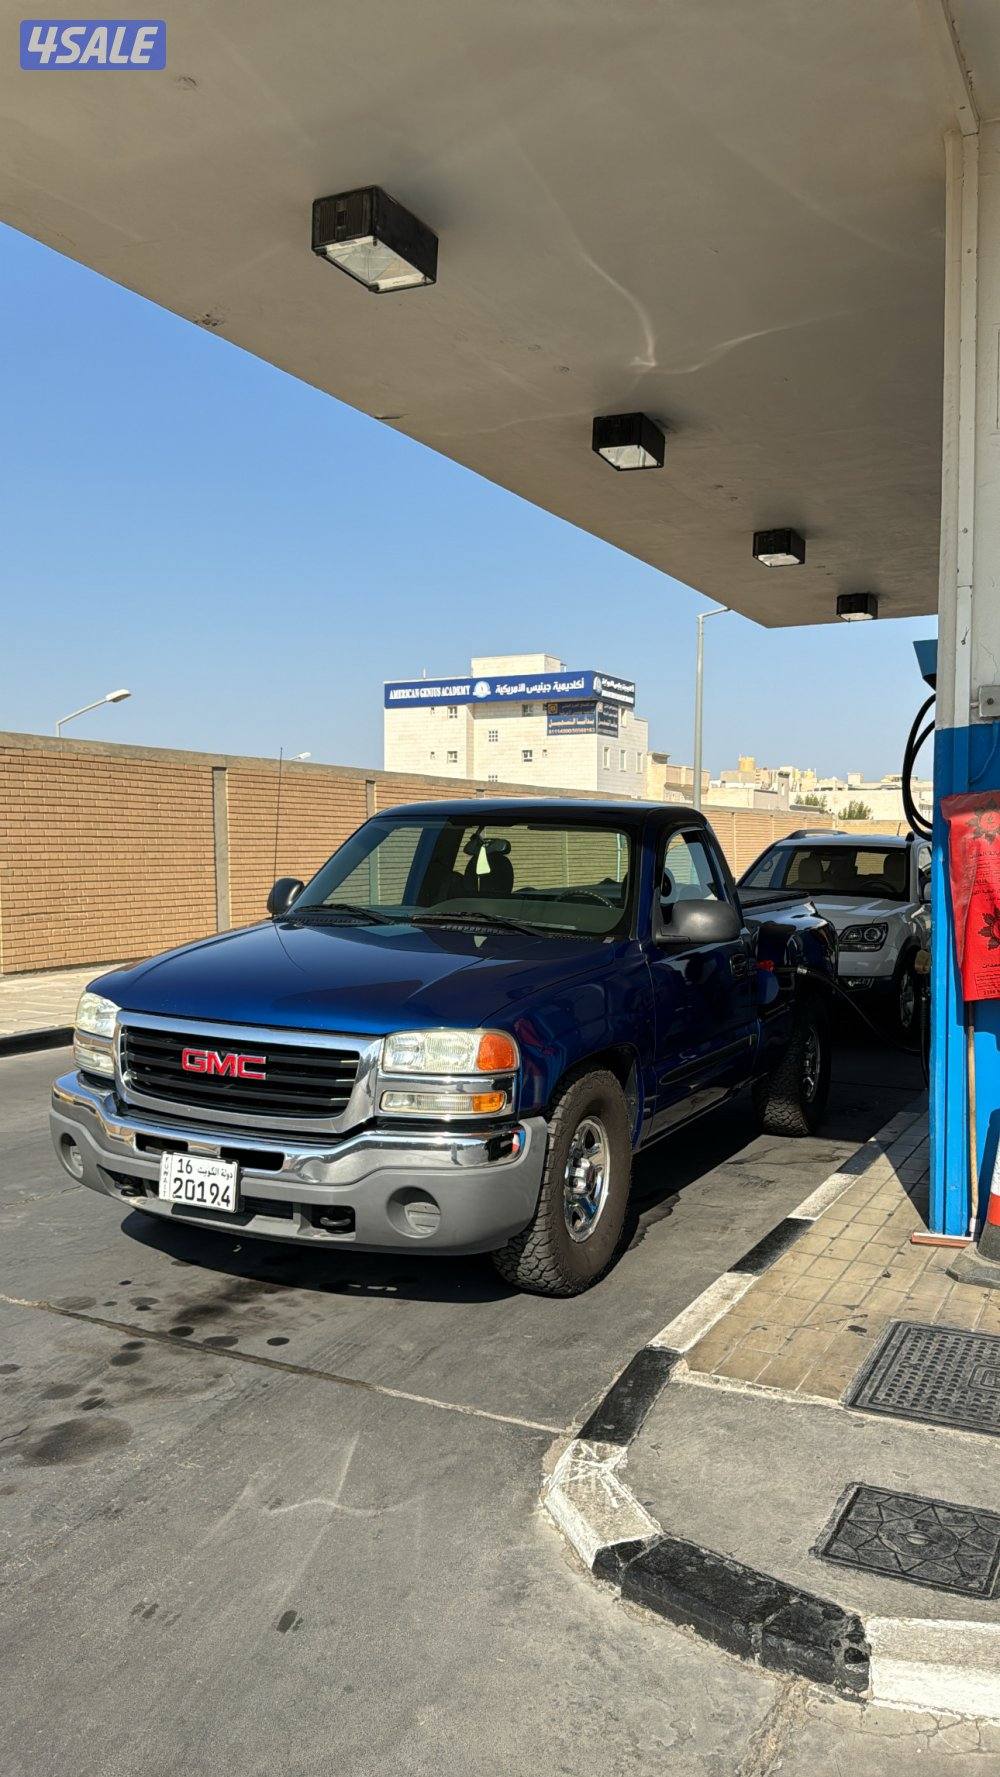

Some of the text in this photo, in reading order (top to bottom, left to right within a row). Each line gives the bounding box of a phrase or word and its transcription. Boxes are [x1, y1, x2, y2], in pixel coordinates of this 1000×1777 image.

[389, 685, 471, 699] AMERICAN GENIUS ACADEMY
[553, 677, 585, 693] أكاديمية
[181, 1048, 267, 1080] GMC
[177, 1158, 193, 1174] 16
[197, 1167, 233, 1180] دولة الكويت
[172, 1177, 231, 1207] 20194
